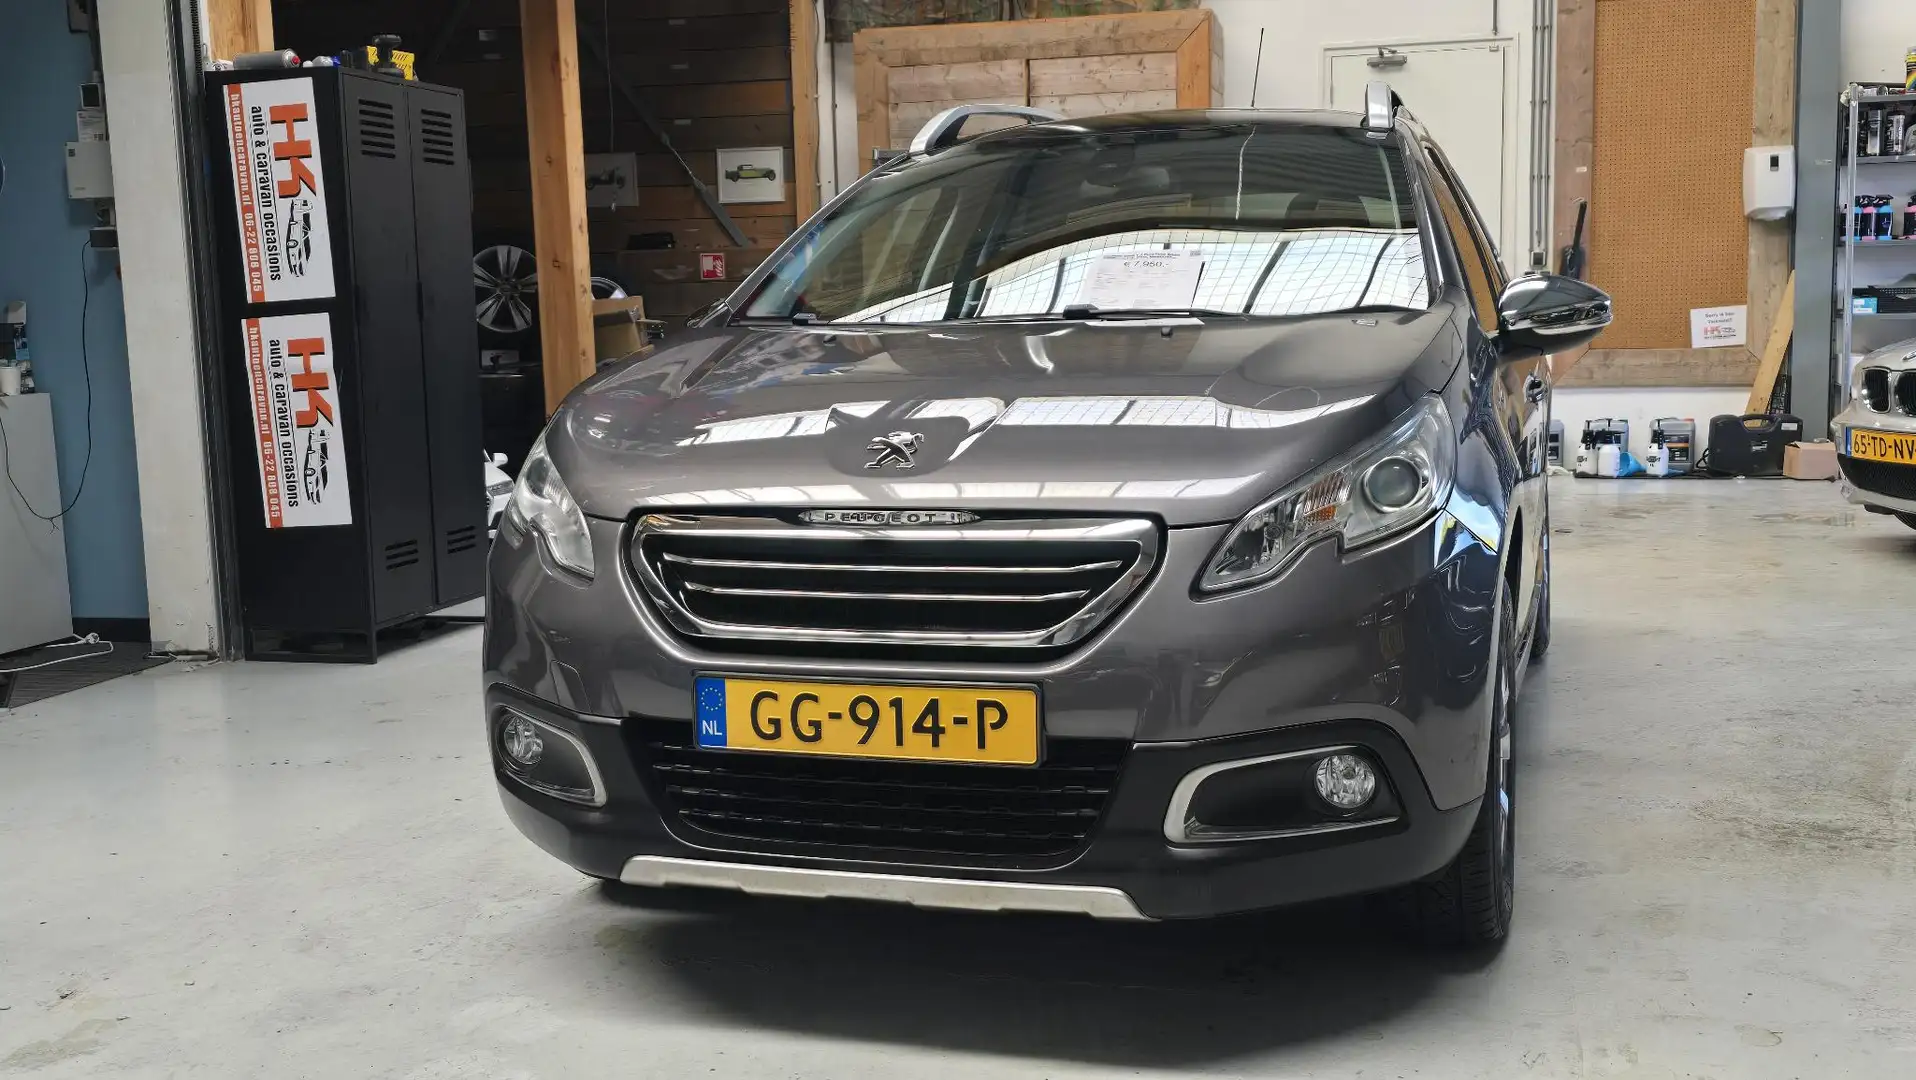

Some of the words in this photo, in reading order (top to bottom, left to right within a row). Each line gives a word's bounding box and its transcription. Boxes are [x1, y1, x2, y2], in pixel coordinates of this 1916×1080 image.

[251, 106, 265, 135] auto
[230, 94, 251, 205] hkautoencaravan.nl
[255, 140, 266, 148] &
[269, 103, 316, 198] HK
[256, 153, 272, 208] caravan
[244, 212, 256, 244] 06-22
[249, 248, 259, 268] 808
[263, 213, 281, 281] occasions
[252, 272, 262, 292] 045
[269, 340, 282, 367] auto
[249, 327, 270, 434] hkautoencaravan.nl
[287, 337, 333, 428] HK
[274, 384, 290, 437] caravan
[263, 441, 275, 471] 06-22
[267, 475, 278, 495] 808
[281, 442, 298, 507] occasions
[270, 498, 280, 518] 045
[824, 512, 937, 523] PEUGEOT
[702, 720, 722, 736] NL
[750, 690, 1008, 749] GG-914-P
